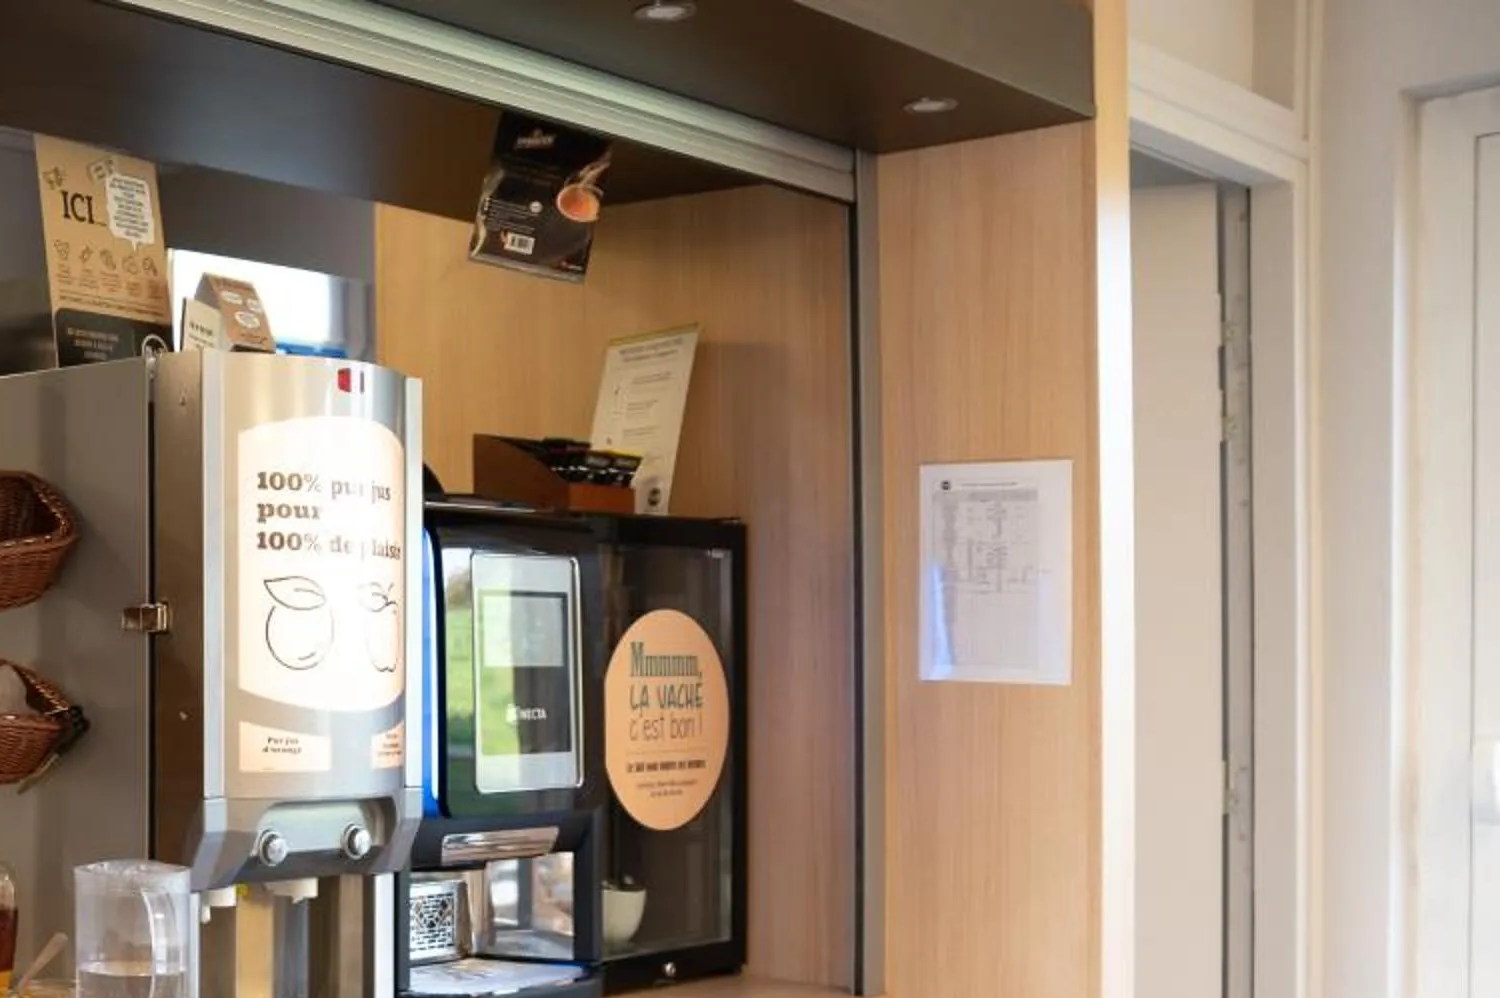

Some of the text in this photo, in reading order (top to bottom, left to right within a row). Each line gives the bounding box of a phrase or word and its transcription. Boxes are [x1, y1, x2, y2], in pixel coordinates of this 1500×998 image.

[256, 471, 322, 493] 100%
[370, 480, 391, 504] jus
[256, 502, 322, 524] pour
[256, 531, 322, 555] 100%
[329, 534, 353, 555] de
[629, 682, 704, 711] LA VACHE
[629, 712, 666, 742] c'est
[670, 710, 695, 740] bon
